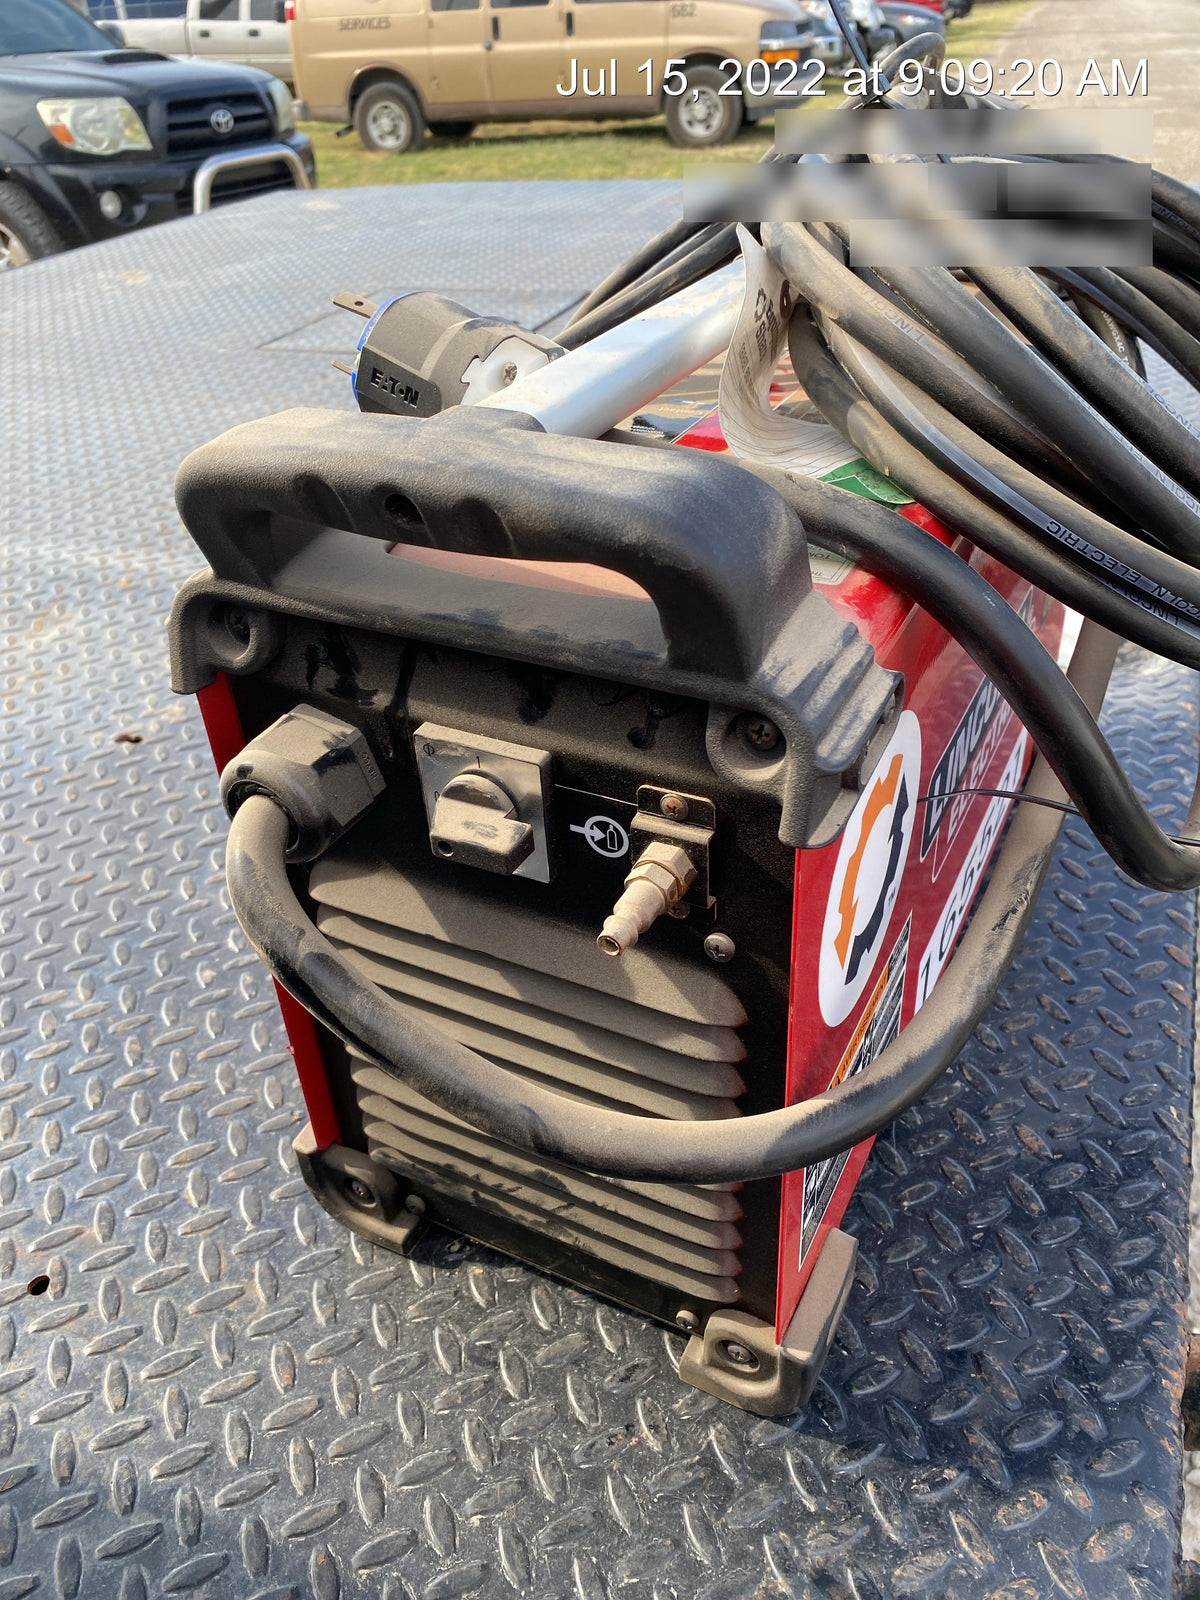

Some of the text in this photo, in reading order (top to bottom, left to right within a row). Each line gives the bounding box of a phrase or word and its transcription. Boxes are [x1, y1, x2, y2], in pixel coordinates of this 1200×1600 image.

[338, 16, 392, 32] SERVICES
[1046, 520, 1142, 583] ELECTRIC
[917, 742, 1023, 1003] 165521
